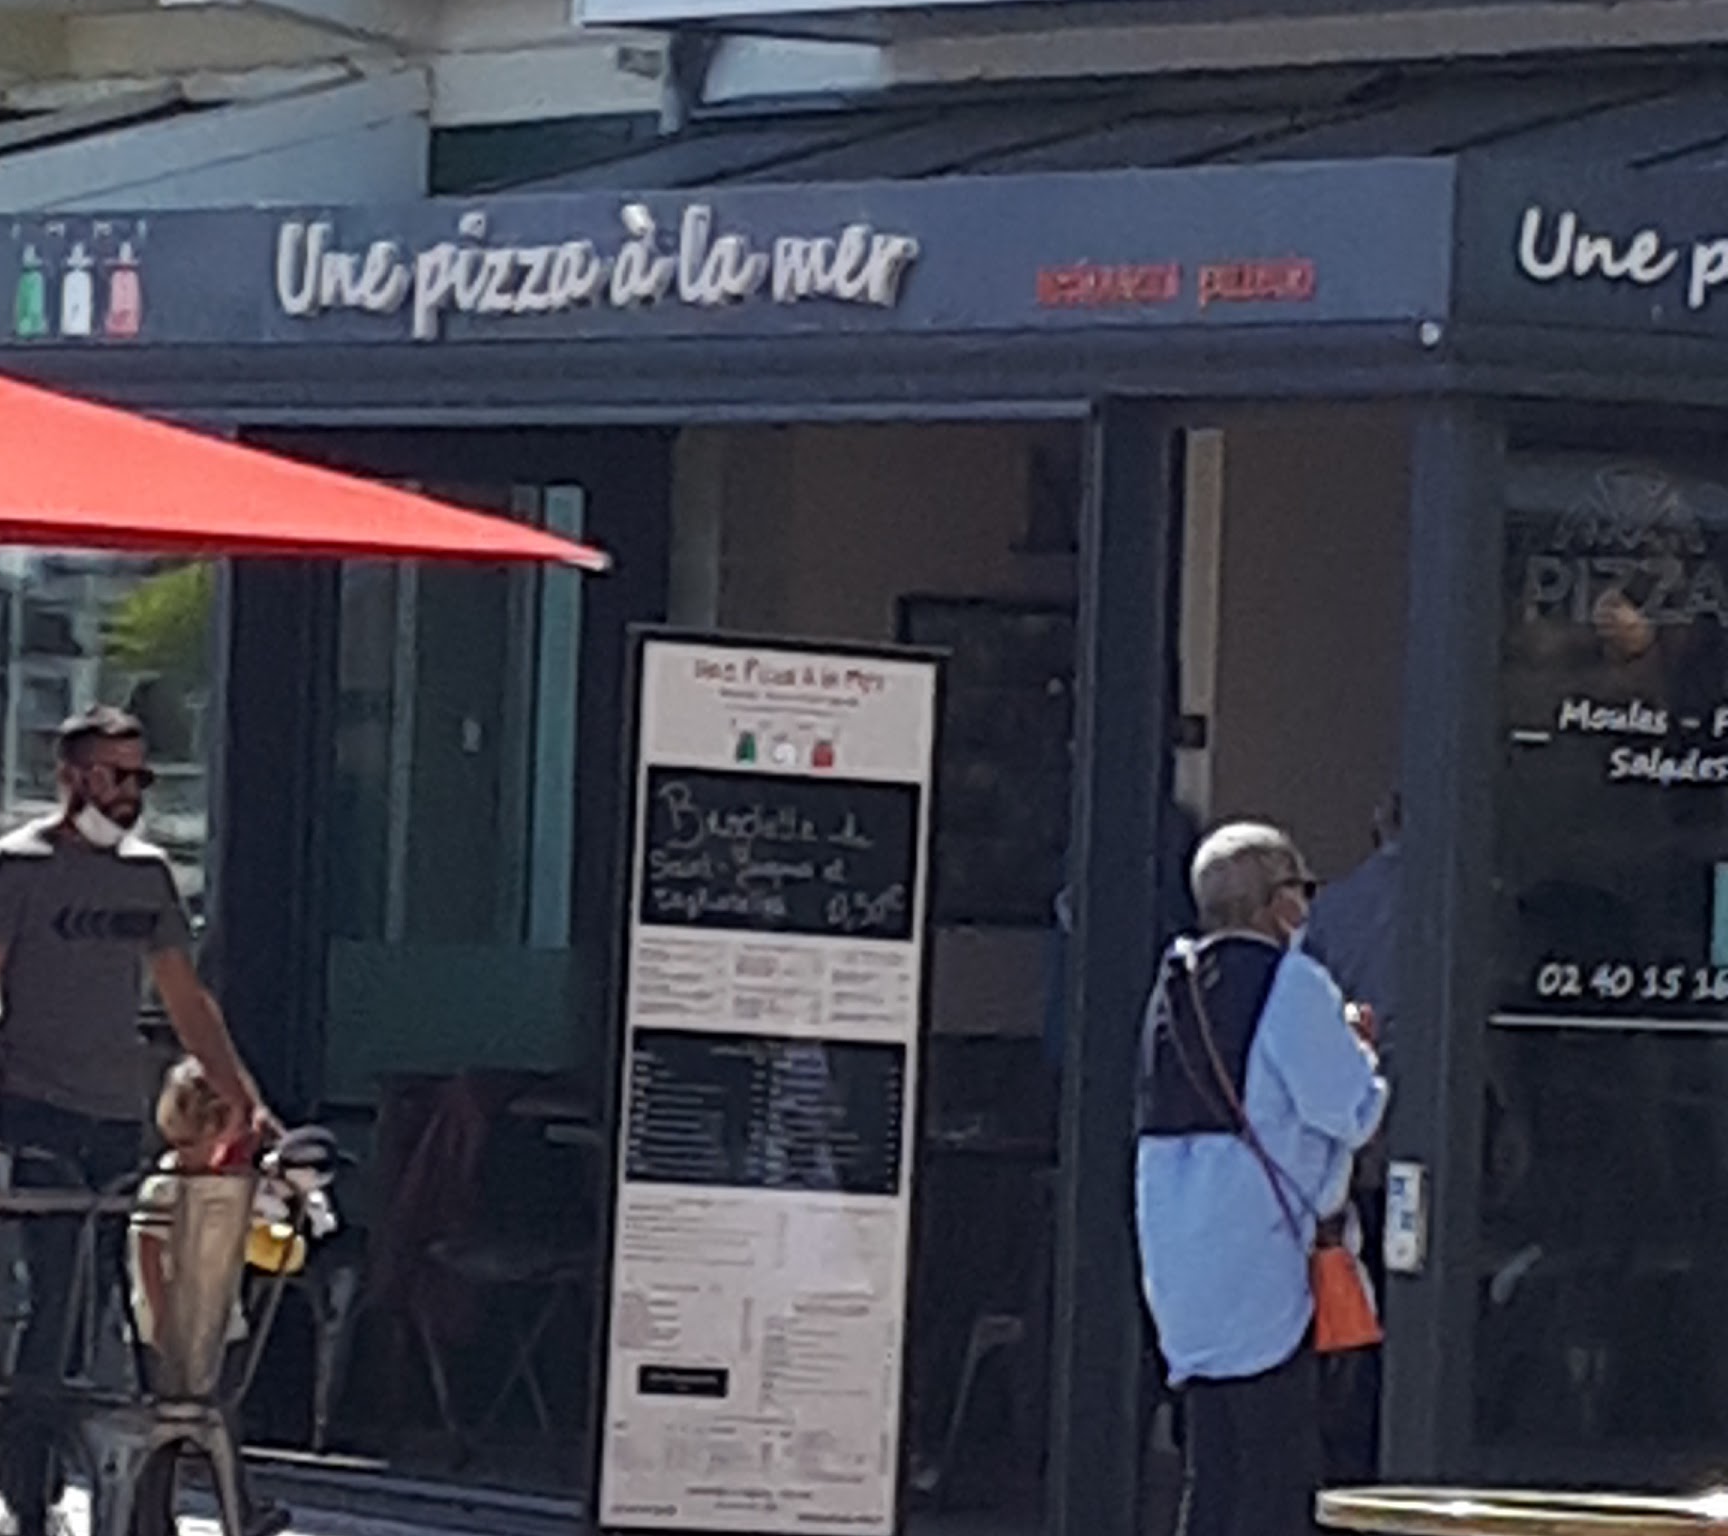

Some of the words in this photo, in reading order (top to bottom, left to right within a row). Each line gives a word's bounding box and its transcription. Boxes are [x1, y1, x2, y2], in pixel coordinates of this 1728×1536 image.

[277, 221, 410, 316] Une
[413, 211, 602, 340] pizza
[610, 203, 671, 306] à
[673, 204, 769, 306] la
[771, 223, 918, 306] mer
[1519, 206, 1679, 282] Une
[1558, 698, 1668, 735] Moules
[1537, 963, 1582, 997] 02
[1589, 964, 1635, 999] 40
[1639, 965, 1685, 999] 15
